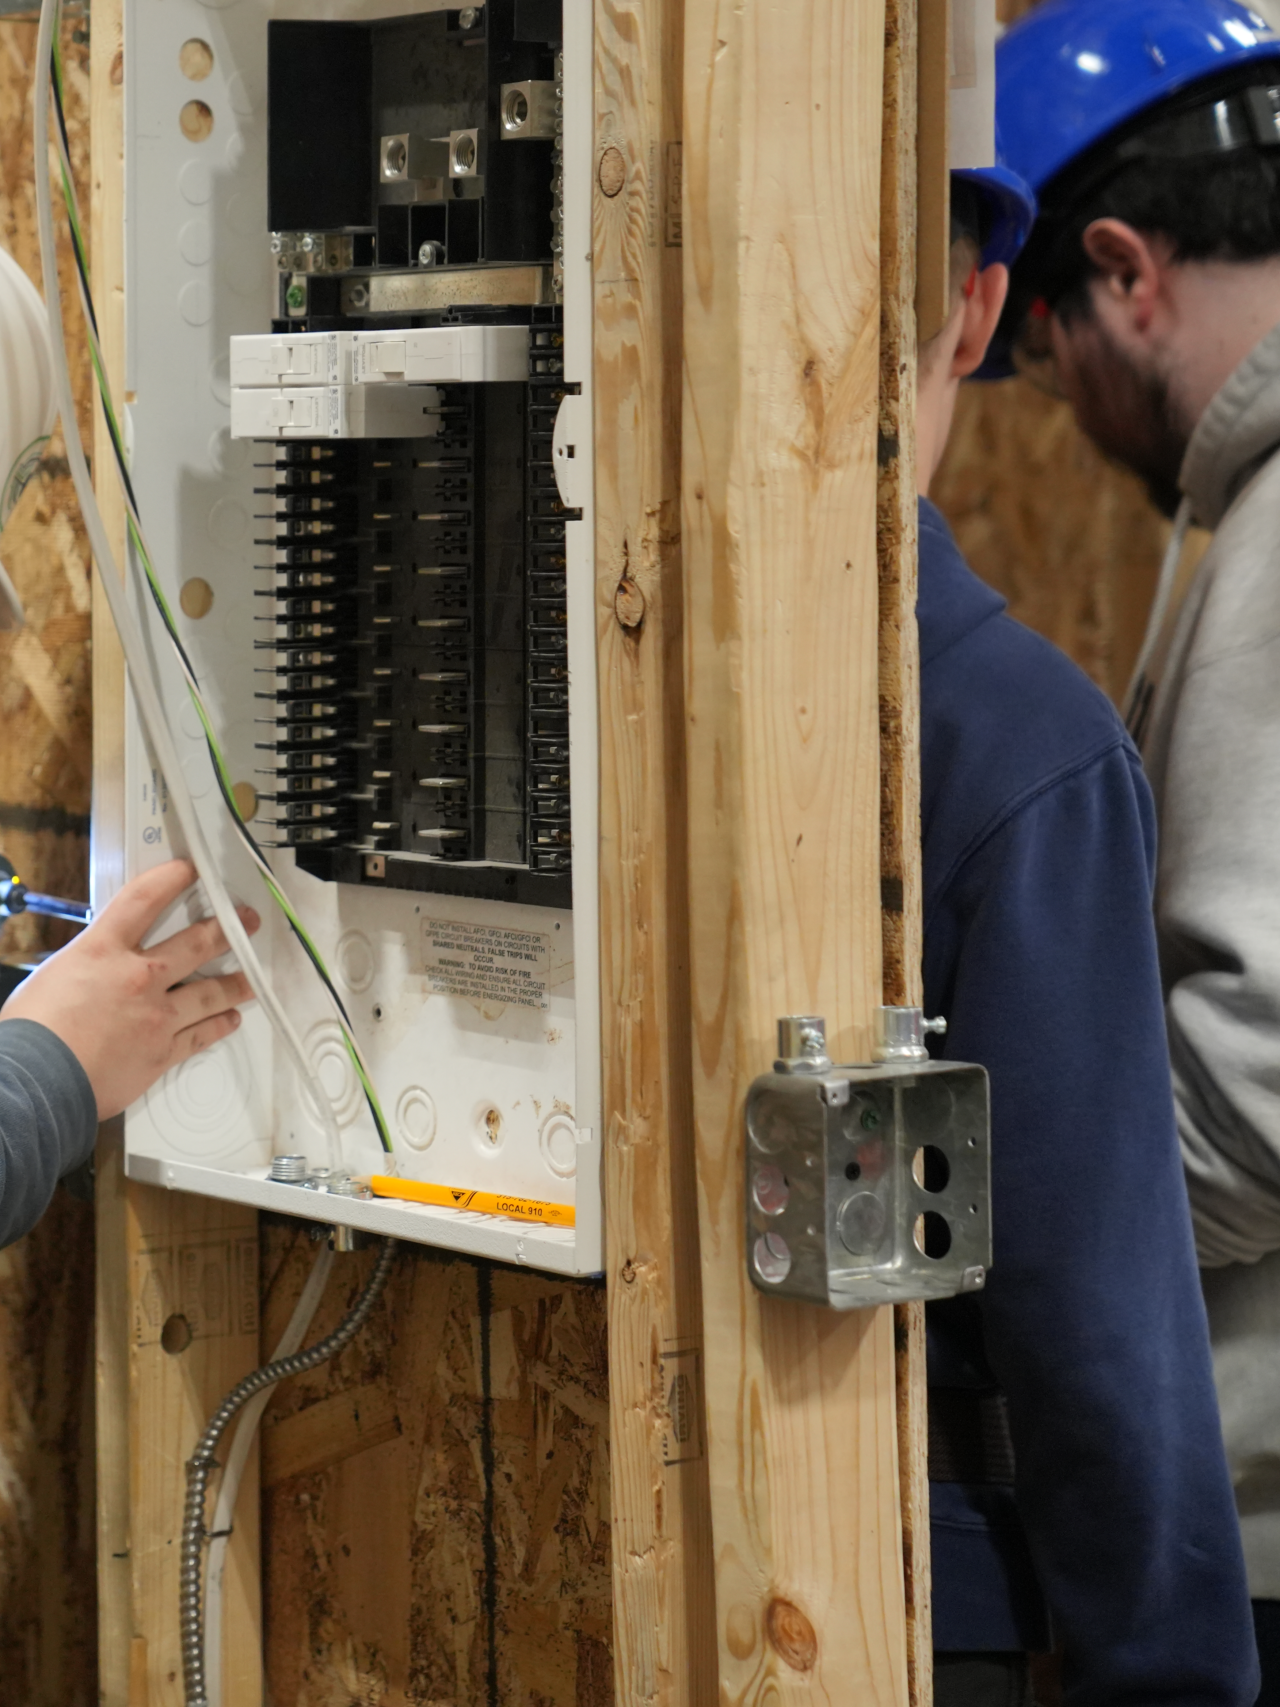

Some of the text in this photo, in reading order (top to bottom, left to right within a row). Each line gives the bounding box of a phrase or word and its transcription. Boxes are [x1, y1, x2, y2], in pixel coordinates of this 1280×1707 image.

[439, 923, 450, 931] NOT
[451, 925, 472, 934] INSTALL
[504, 933, 531, 942] AFCI/GFCI
[441, 932, 462, 941] CIRCUIT
[463, 935, 493, 946] BREAKERS
[494, 939, 502, 947] ON
[504, 941, 529, 951] CIRCUITS
[531, 945, 545, 953] WITH
[433, 940, 455, 949] SHARED
[488, 947, 505, 956] FALSE
[507, 950, 524, 959] TRIPS
[524, 953, 538, 961] WILL
[425, 965, 546, 990] CHECK ALL WIRING AND ENSURE ALL CIRCUIT
[438, 958, 466, 968] WARNING:
[477, 964, 494, 973] AVOID
[495, 967, 508, 975] RISK
[519, 970, 531, 978] FIRE
[428, 974, 457, 985] BREAKERS
[458, 979, 469, 987] ARE
[470, 981, 499, 991] INSTALLED
[507, 987, 518, 995] THE
[519, 989, 543, 998] PROPER
[433, 984, 459, 994] POSITION
[460, 988, 481, 997] BEFORE
[483, 991, 517, 1004] ENERGIZING
[496, 1202, 526, 1214] LOCAL
[528, 1206, 543, 1217] 910
[677, 1374, 686, 1443] IRVING
